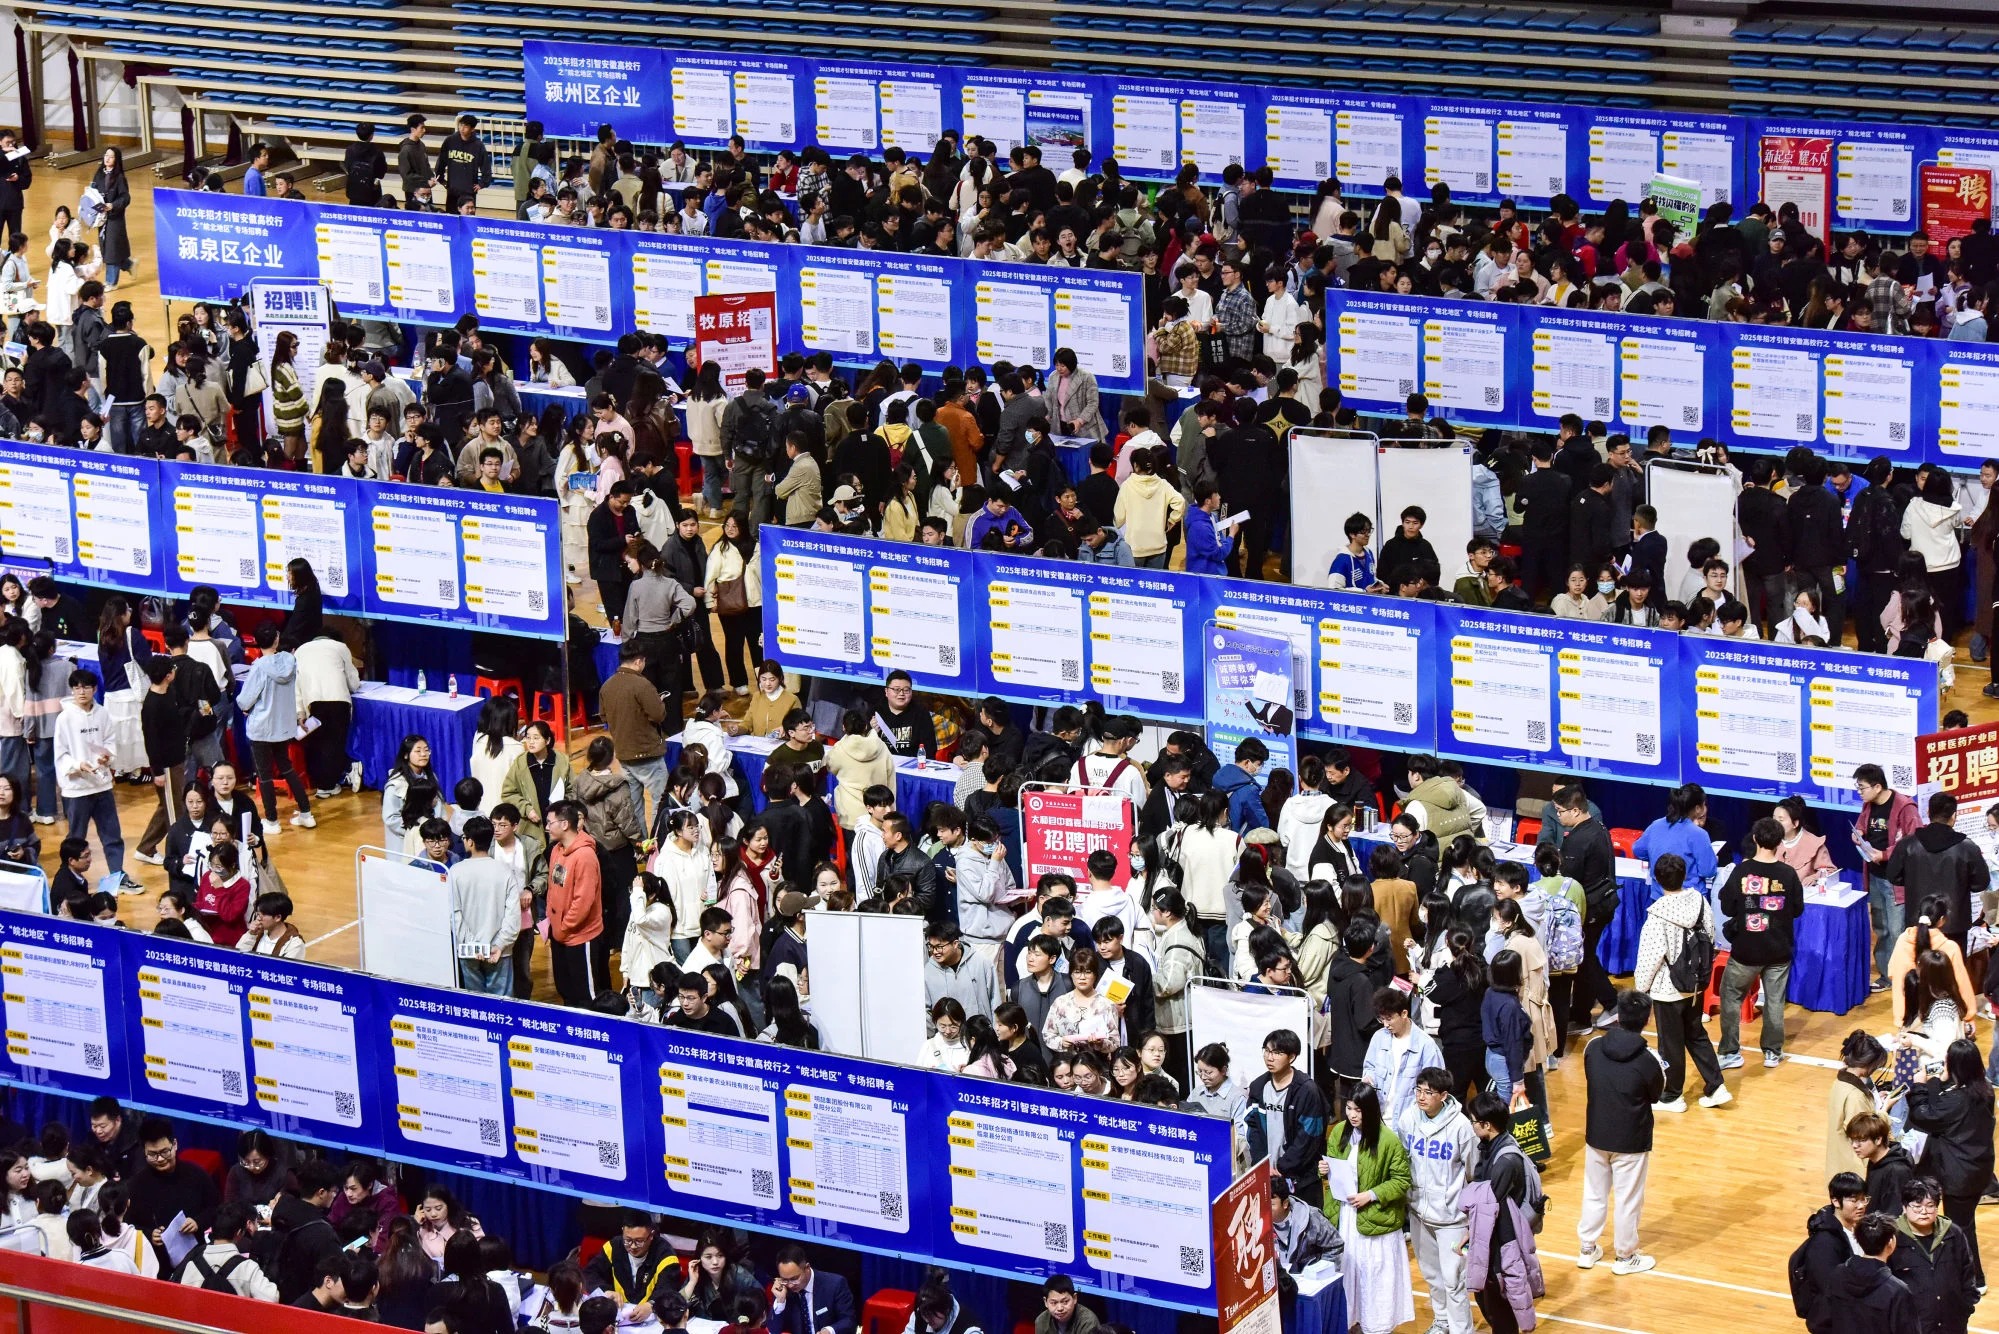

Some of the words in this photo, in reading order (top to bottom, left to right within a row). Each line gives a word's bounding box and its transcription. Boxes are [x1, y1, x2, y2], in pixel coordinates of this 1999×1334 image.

[544, 56, 640, 72] 2025年招才引智安徽高校行
[545, 80, 641, 108] 颍州区企业
[1764, 150, 1795, 164] 新起点
[1799, 150, 1828, 166] 耀不凡
[1956, 174, 1988, 210] 聘
[176, 208, 283, 227] 2025年招才引智安徽高校行
[178, 234, 284, 268] 颍泉区企业
[782, 539, 949, 568] 2025年招才引智安徽高校行之“皖北地区”专场招聘会
[996, 566, 1175, 592] 2025年招才引智安徽高校行之“皖北地区”专场招聘会
[1224, 590, 1410, 619] 2025年招才引智安徽高校行之“皖北地区”专场招聘会
[1460, 620, 1651, 649] 2025年招才引智安徽高校行之“皖北地区”专场招聘会
[1705, 650, 1910, 681] 2025年招才引智安徽高校行之“皖北地区”专场招聘会
[1927, 731, 1997, 754] 悦康医药产业园
[1093, 768, 1108, 778] NBA
[1927, 746, 1999, 792] 招聘
[1044, 829, 1108, 854] 招聘啦
[145, 950, 343, 994] 2025年招才引智安徽高校行之“皖北地区”专场招聘会
[342, 1005, 356, 1014] A140
[398, 997, 610, 1042] 2025年招才引智安徽高校行之“皖北地区”专场招聘会
[487, 1031, 502, 1040] A141
[511, 1043, 529, 1051] 企业名称
[609, 1053, 623, 1063] A142
[512, 1060, 529, 1068] 企业简介
[668, 1044, 895, 1091] 2025年招才引智安徽高校行之“皖北地区”专场招聘会
[663, 1070, 681, 1078] 企业名称
[764, 1080, 779, 1090] A143
[514, 1089, 531, 1097] 招聘岗位
[663, 1087, 682, 1095] 企业简介
[788, 1092, 807, 1100] 企业名称
[813, 1103, 842, 1114] 阜阳分公司
[893, 1102, 908, 1111] A144
[789, 1110, 808, 1118] 企业简介
[958, 1092, 1197, 1142] 2025年招才引智安徽高校行之“皖北地区”专场招聘会
[665, 1117, 683, 1125] 招聘岗位
[951, 1119, 971, 1127] 企业名称
[517, 1128, 534, 1136] 工作地址
[976, 1122, 1049, 1141] 中国联合网络通信有限公司
[1059, 1130, 1075, 1139] A145
[790, 1139, 809, 1147] 招聘岗位
[951, 1137, 971, 1145] 企业简介
[518, 1143, 535, 1151] 联系电话
[1084, 1142, 1105, 1150] 企业名称
[667, 1156, 685, 1164] 工作地址
[1195, 1153, 1212, 1162] A146
[1085, 1160, 1106, 1168] 企业简介
[668, 1172, 687, 1180] 联系电话
[953, 1168, 972, 1176] 招聘岗位
[792, 1180, 811, 1188] 工作地址
[793, 1195, 812, 1203] 联系电话
[1086, 1191, 1107, 1199] 招聘岗位
[954, 1208, 974, 1216] 工作地址
[955, 1224, 975, 1232] 联系电话
[1087, 1232, 1107, 1240] 工作地址
[1087, 1249, 1108, 1257] 联系电话
